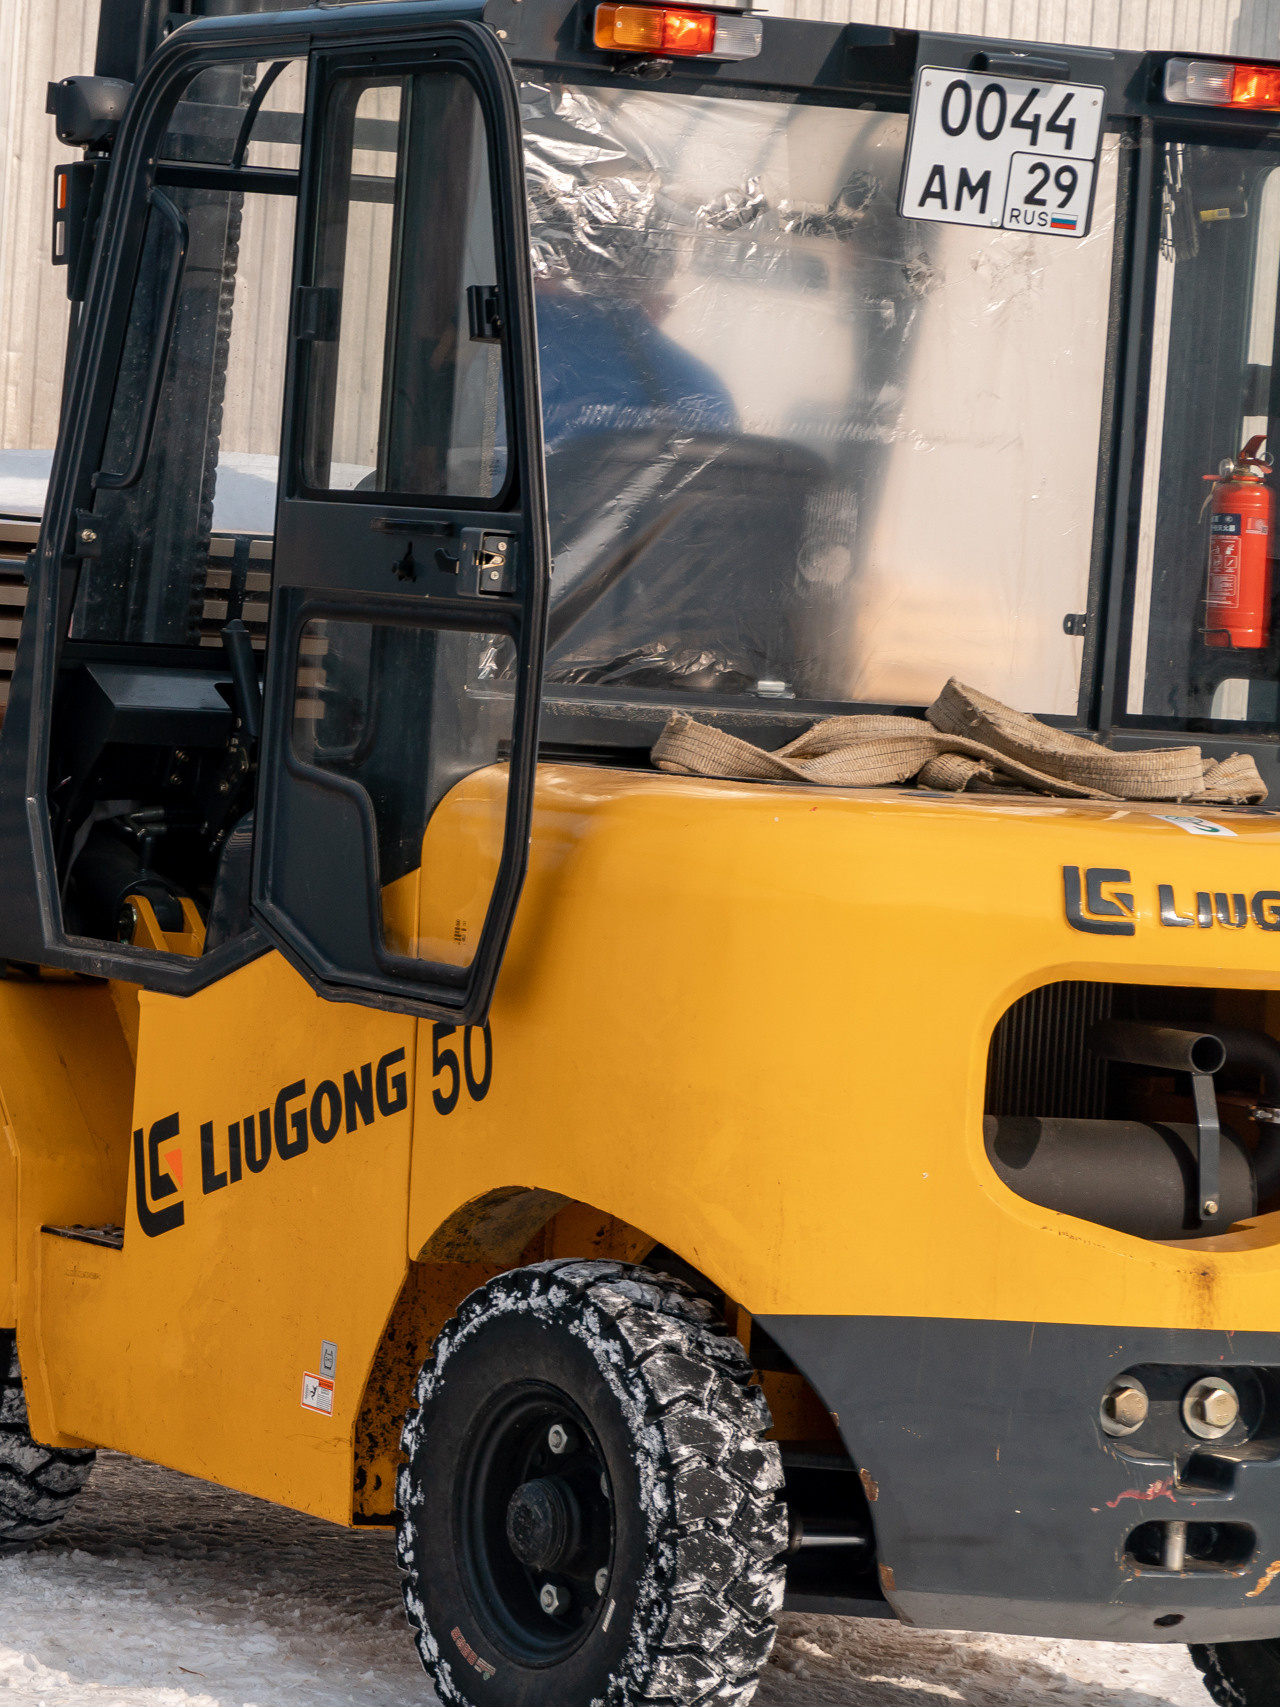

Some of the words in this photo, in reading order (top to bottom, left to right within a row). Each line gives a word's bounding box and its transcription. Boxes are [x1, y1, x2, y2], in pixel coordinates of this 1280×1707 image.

[940, 79, 1077, 150] 0044
[1023, 161, 1079, 209] 29
[1009, 207, 1049, 227] RUS
[432, 1018, 493, 1116] 50
